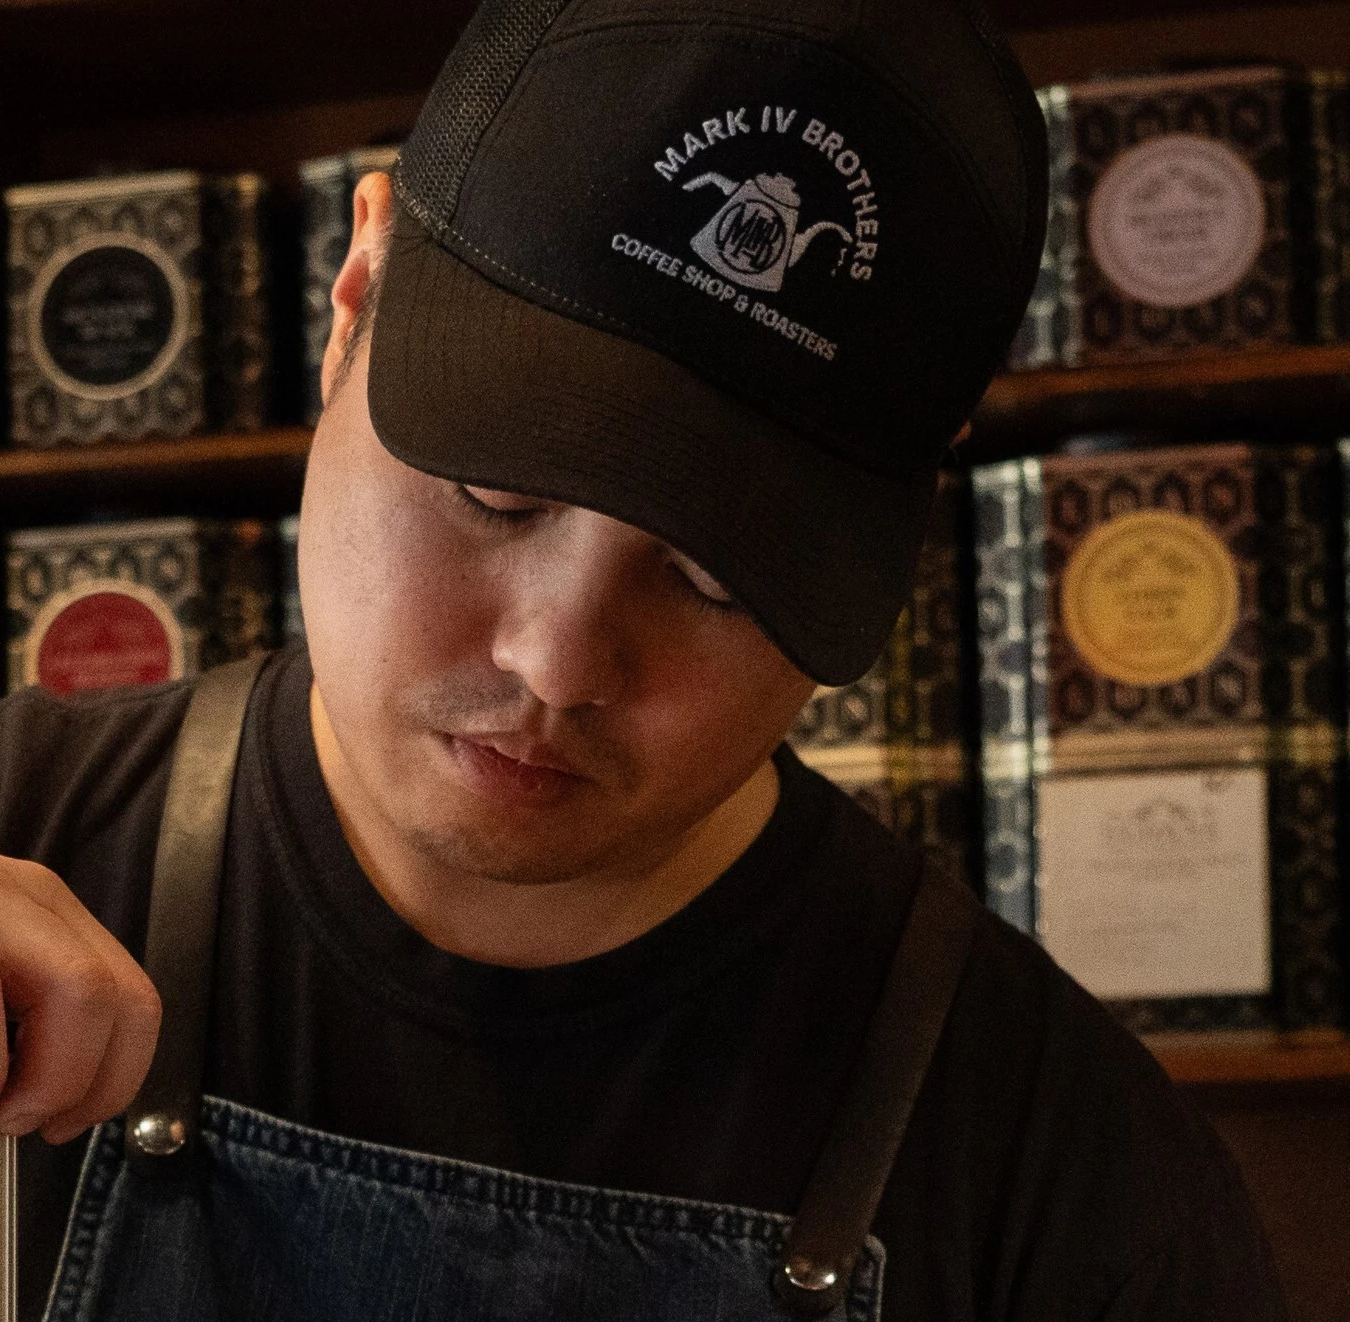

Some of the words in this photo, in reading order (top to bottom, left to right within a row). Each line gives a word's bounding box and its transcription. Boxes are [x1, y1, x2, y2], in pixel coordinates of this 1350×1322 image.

[654, 107, 750, 181] MARK
[760, 105, 797, 133] IV
[802, 118, 878, 281] BROTHERS
[611, 233, 683, 278] COFFEE
[681, 264, 737, 302] SHOP
[733, 294, 749, 313] &
[750, 302, 838, 361] ROASTERS
